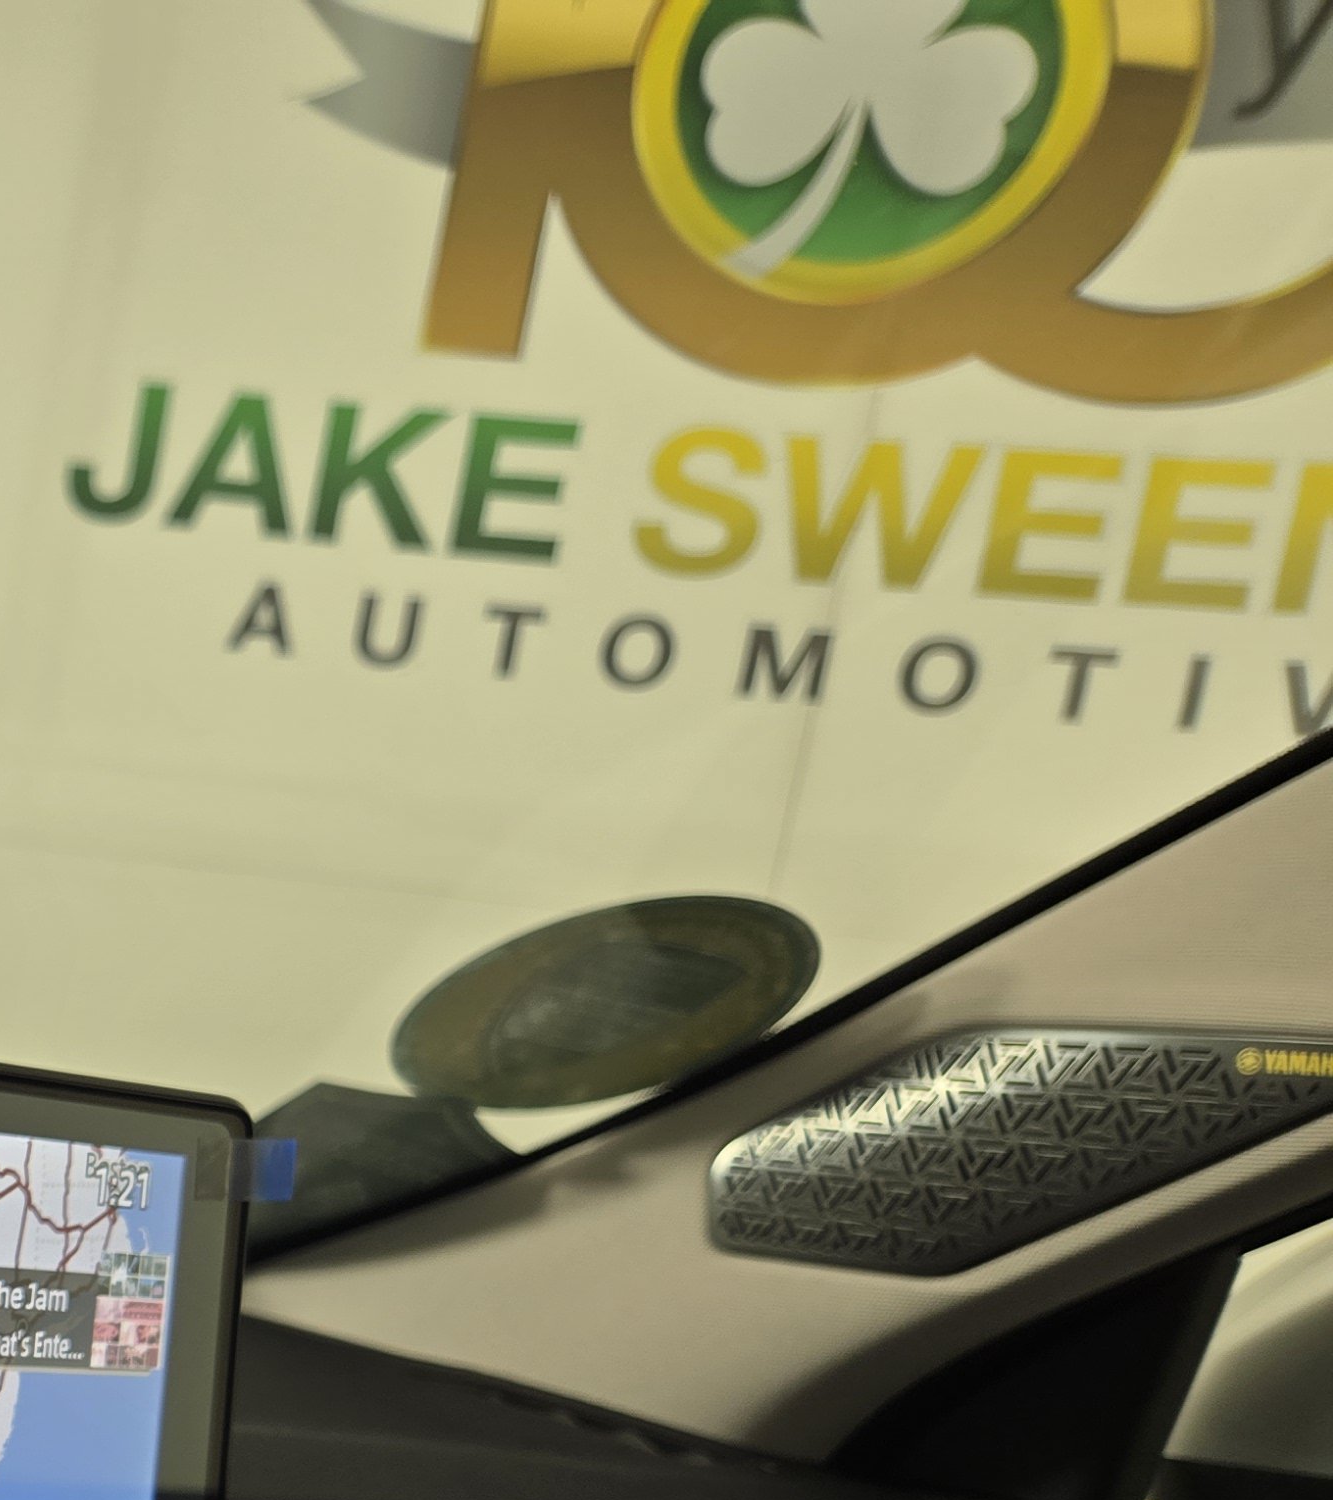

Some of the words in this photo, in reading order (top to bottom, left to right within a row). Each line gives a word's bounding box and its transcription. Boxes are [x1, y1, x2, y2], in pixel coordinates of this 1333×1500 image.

[64, 380, 583, 565] JAKE
[96, 1166, 150, 1209] 1:21
[26, 1282, 69, 1312] Jam
[34, 1330, 85, 1361] Ente...
